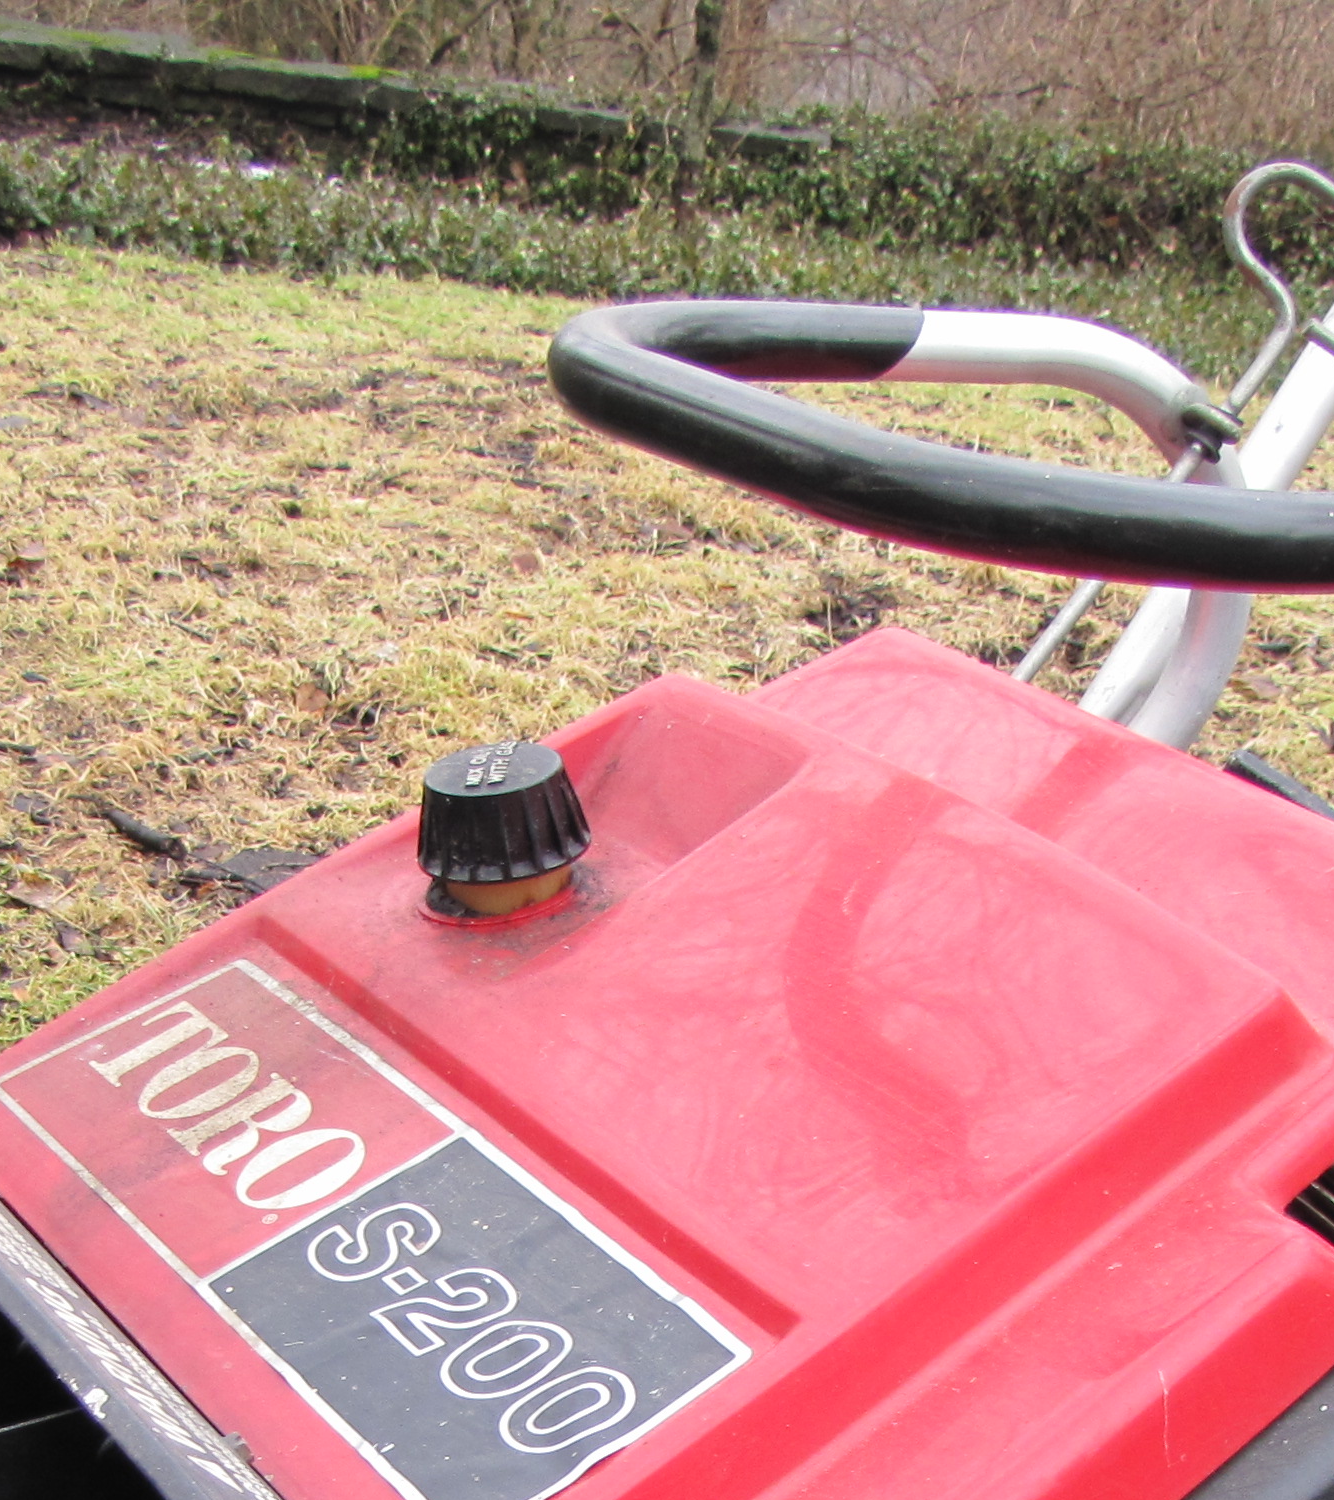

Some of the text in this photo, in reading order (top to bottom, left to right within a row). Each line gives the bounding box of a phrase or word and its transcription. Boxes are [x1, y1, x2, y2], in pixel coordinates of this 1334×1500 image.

[465, 767, 485, 786] MIX
[487, 758, 510, 784] WITH
[88, 1000, 366, 1210] TORO
[24, 1276, 208, 1453] WARNING
[307, 1202, 636, 1454] S-200
